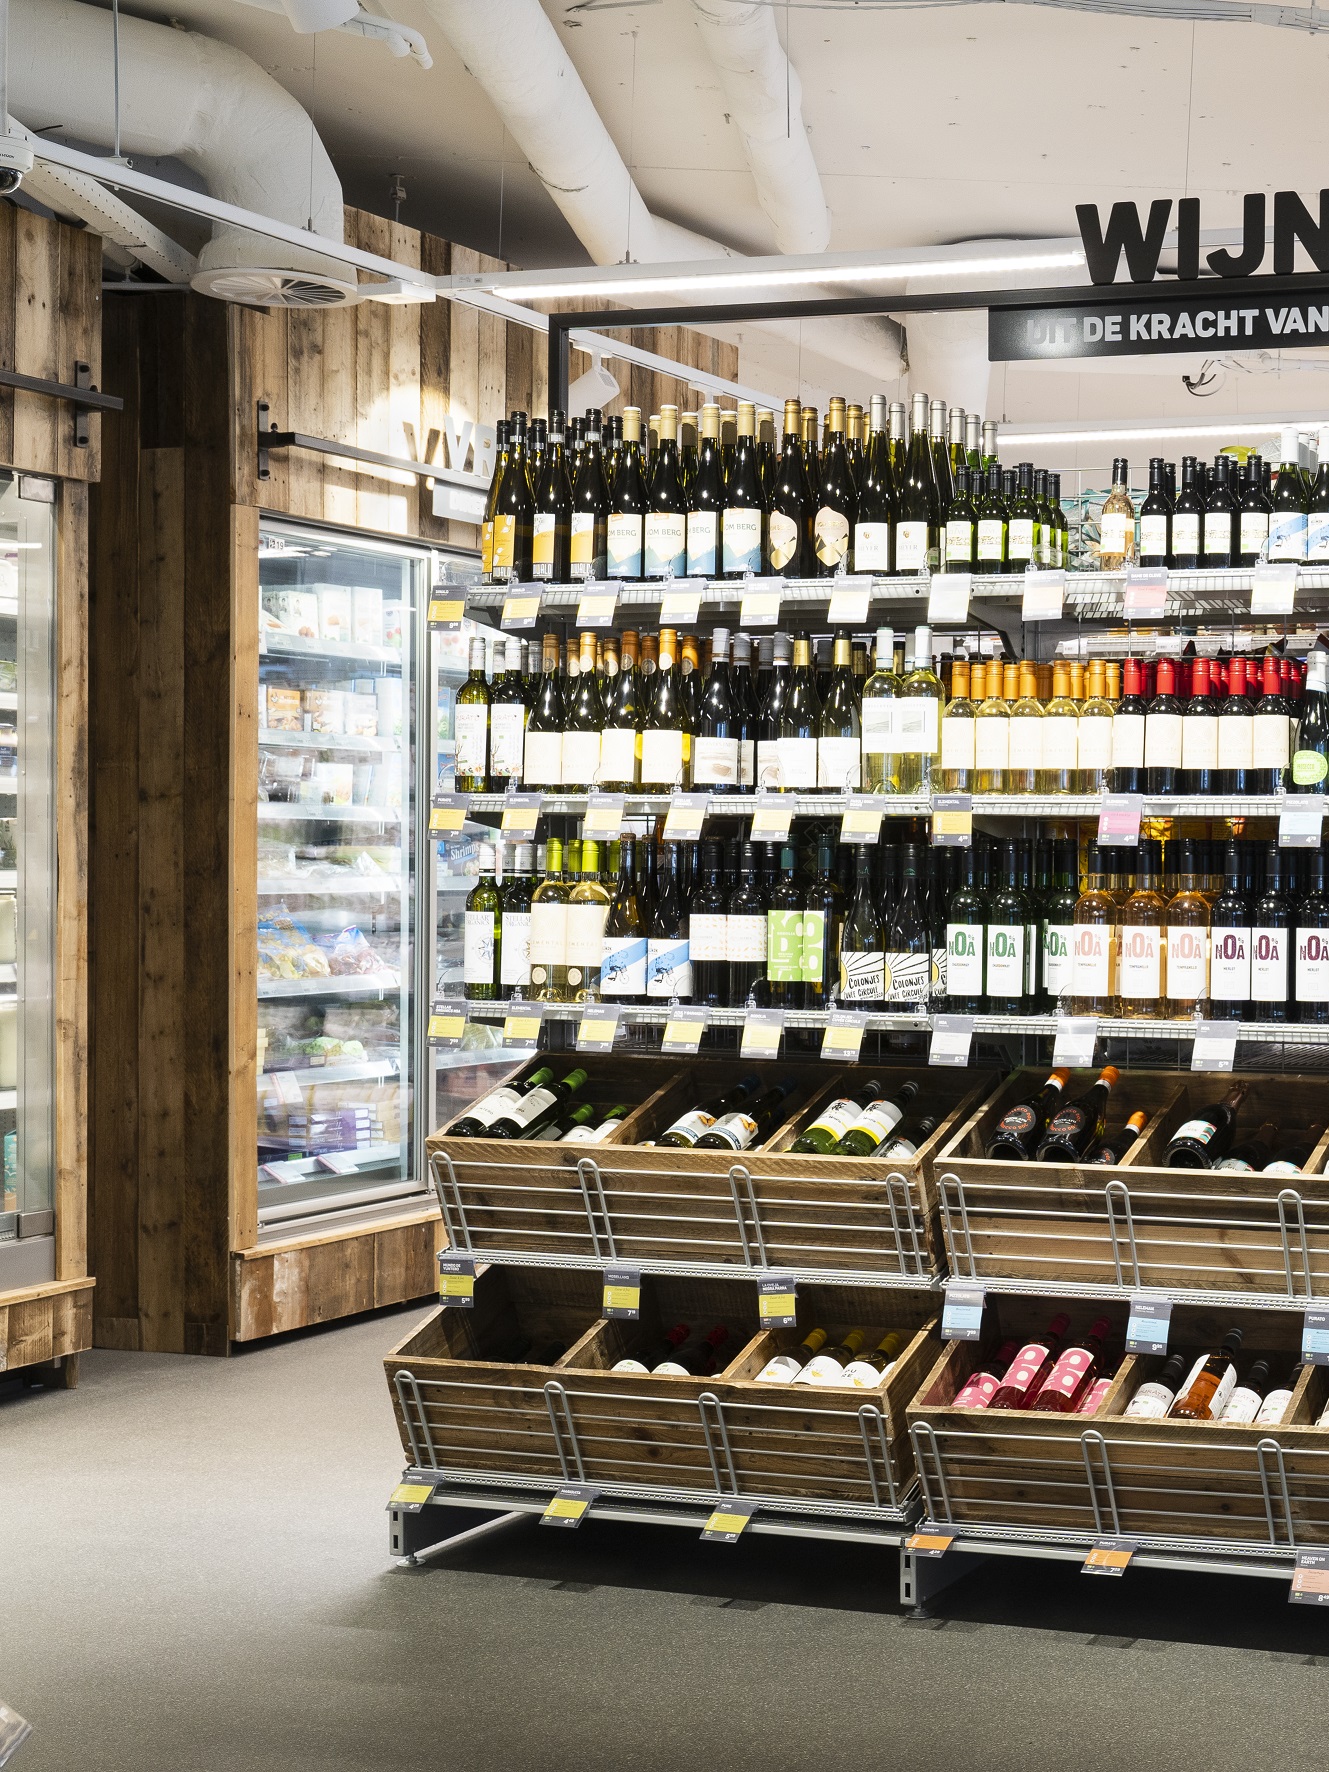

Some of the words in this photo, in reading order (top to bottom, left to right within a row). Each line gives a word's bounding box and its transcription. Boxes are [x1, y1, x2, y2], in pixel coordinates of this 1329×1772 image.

[1026, 316, 1078, 345] UIT
[1083, 314, 1123, 344] DE
[1129, 308, 1259, 342] KRACHT
[1265, 305, 1329, 333] VAN
[662, 528, 682, 537] BERG
[737, 523, 757, 531] BERG
[450, 843, 480, 860] Shrimps
[1074, 931, 1102, 956] NOA
[1125, 932, 1154, 958] NOA
[1172, 933, 1202, 959] NOA
[1215, 934, 1245, 960] NOA
[1299, 935, 1329, 961] NOA
